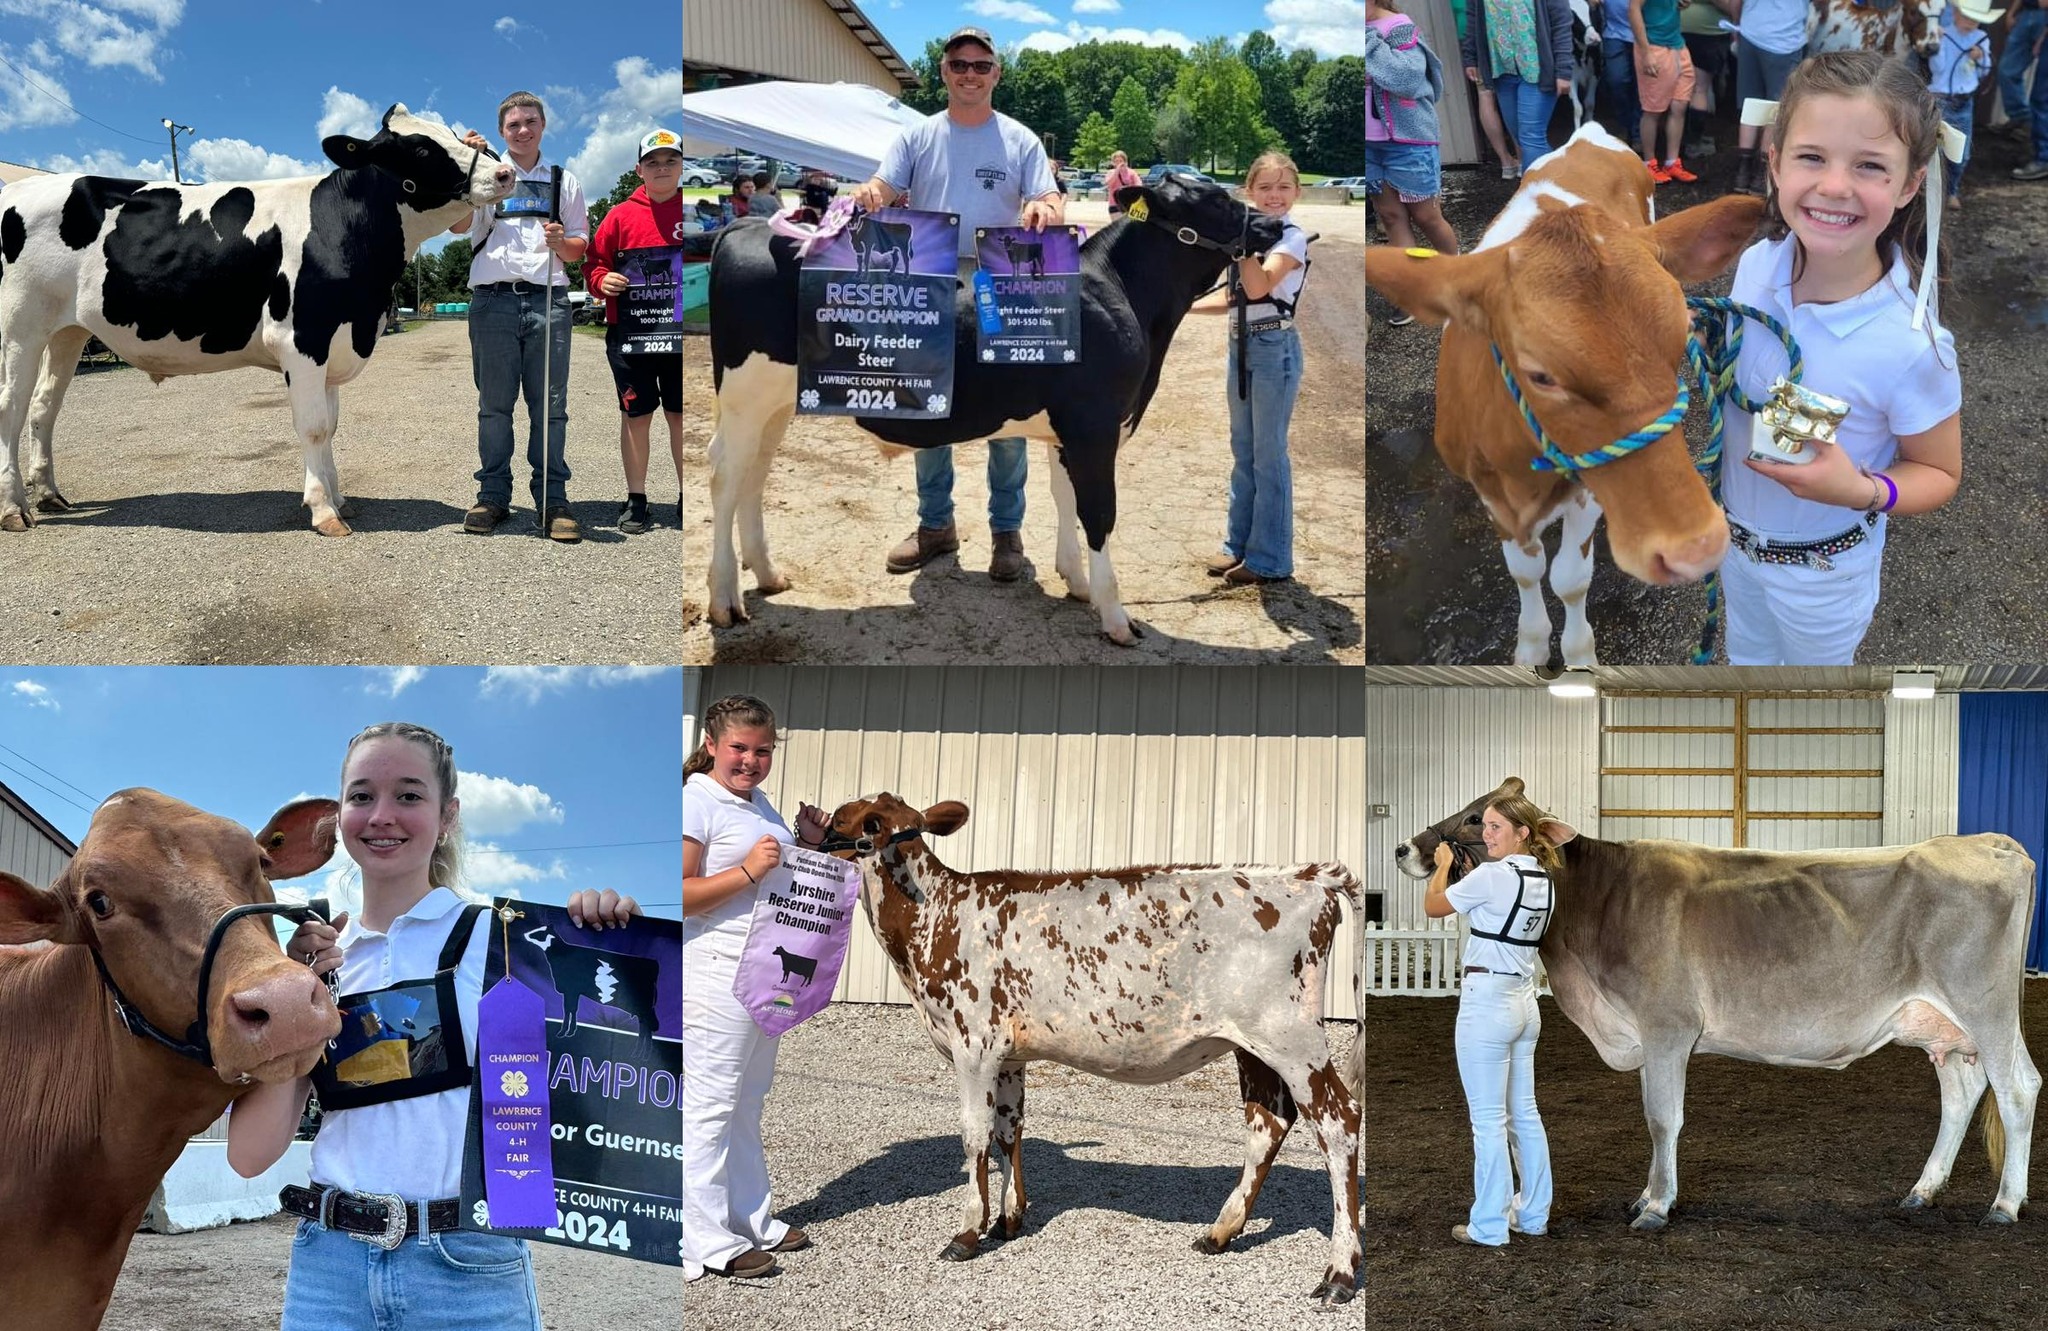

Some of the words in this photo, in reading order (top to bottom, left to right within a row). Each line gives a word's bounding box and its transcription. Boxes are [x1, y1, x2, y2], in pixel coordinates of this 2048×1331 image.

[629, 289, 676, 300] CHAMPI
[826, 282, 928, 308] RESERVE
[994, 281, 1066, 295] CHAMPION
[631, 309, 648, 317] Light
[650, 307, 674, 316] Weight
[816, 308, 864, 323] GRAND
[867, 309, 940, 325] CHAMPION
[997, 306, 1012, 316] ight
[644, 342, 673, 352] 2024
[835, 333, 870, 351] Dairy
[874, 335, 922, 349] Feeder
[858, 353, 895, 367] Steer
[1010, 348, 1045, 361] 2024
[818, 376, 859, 385] LAWRENCE
[861, 376, 896, 387] COUNTY
[897, 378, 912, 387] 4-H
[913, 379, 933, 388] FAIR
[846, 390, 896, 410] 2024
[783, 862, 797, 870] Dairy
[811, 869, 825, 877] Open
[790, 881, 835, 902] Ayrshire
[768, 892, 815, 915] Reserve
[817, 904, 844, 922] Junior
[775, 911, 831, 935] Champion
[1523, 916, 1542, 932] 57
[489, 1054, 539, 1063] CHAMPION
[547, 1050, 683, 1111] AMPIO
[493, 1107, 542, 1116] LAWRENCE
[496, 1122, 538, 1131] COUNTY
[509, 1138, 527, 1146] 4-H
[585, 1123, 683, 1160] Guernse
[506, 1154, 529, 1163] FAIR
[570, 1191, 630, 1213] COUNTY
[633, 1201, 656, 1218] 4-H
[660, 1206, 683, 1222] FAI
[545, 1209, 631, 1250] 2024
